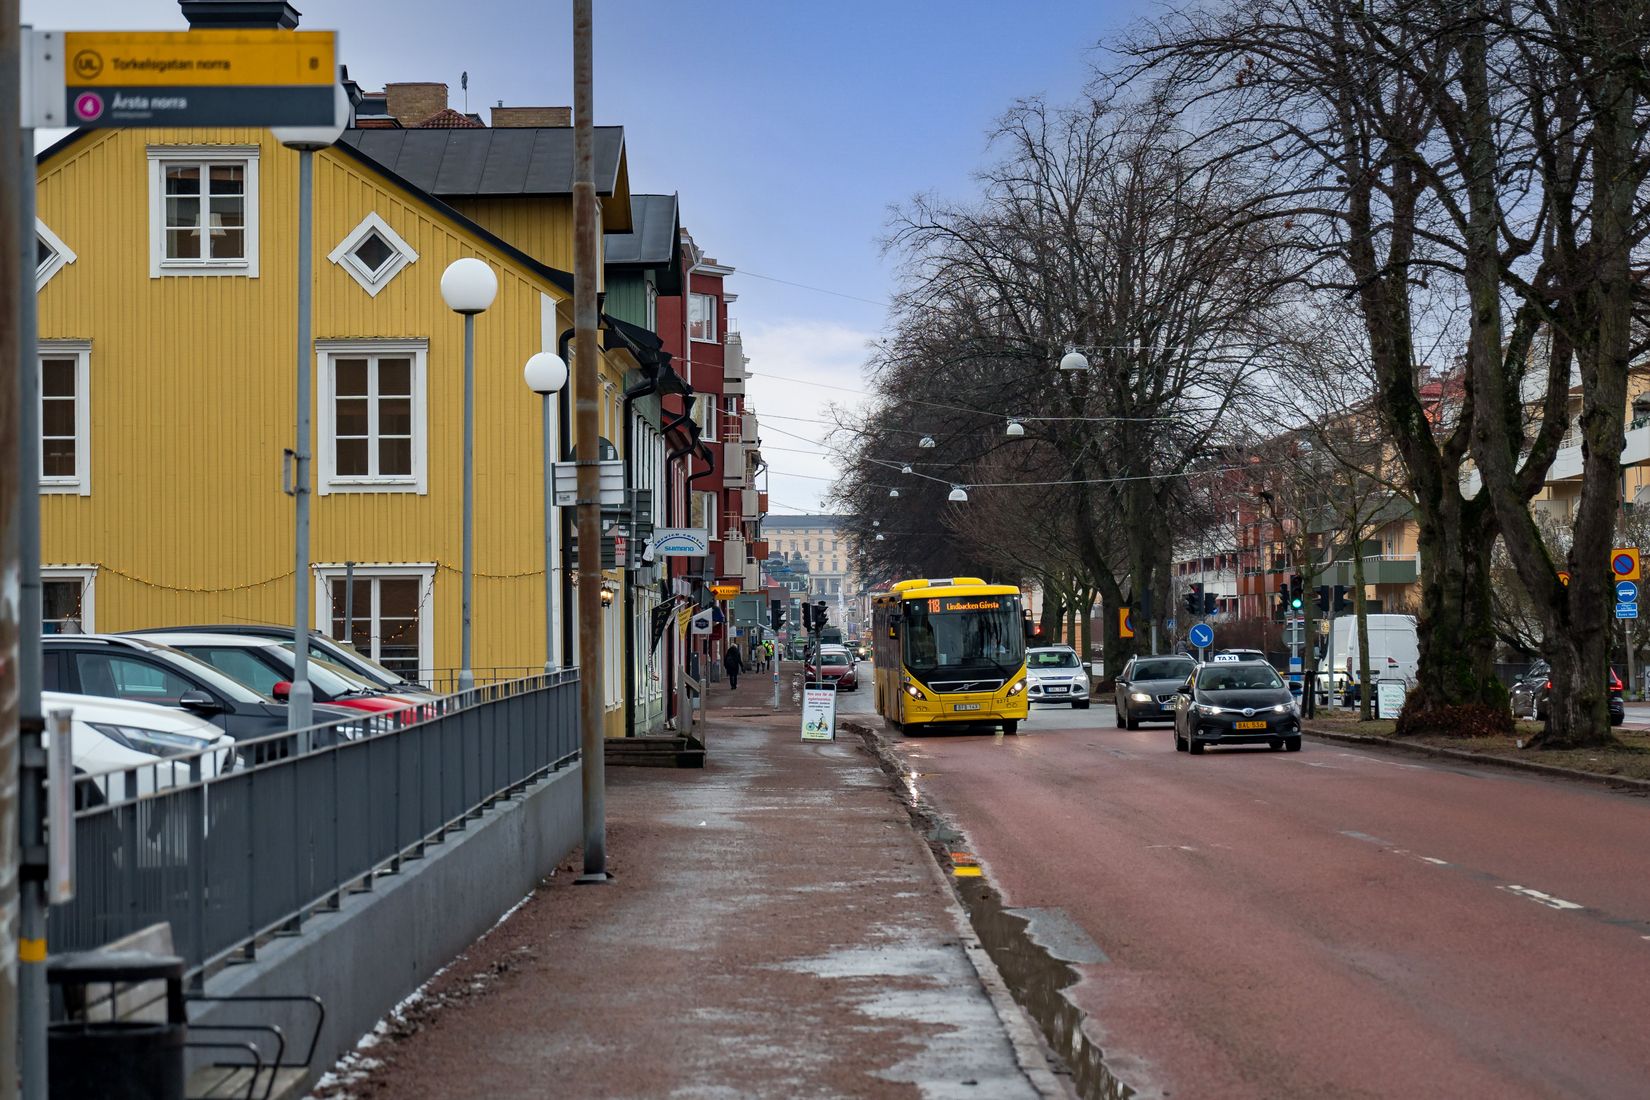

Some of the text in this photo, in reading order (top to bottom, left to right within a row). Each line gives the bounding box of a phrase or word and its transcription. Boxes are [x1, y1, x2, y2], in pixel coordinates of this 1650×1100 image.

[79, 59, 97, 70] UL
[196, 60, 231, 71] norra
[83, 100, 95, 113] 4
[112, 92, 188, 109] Årsta norra
[928, 599, 941, 613] 118
